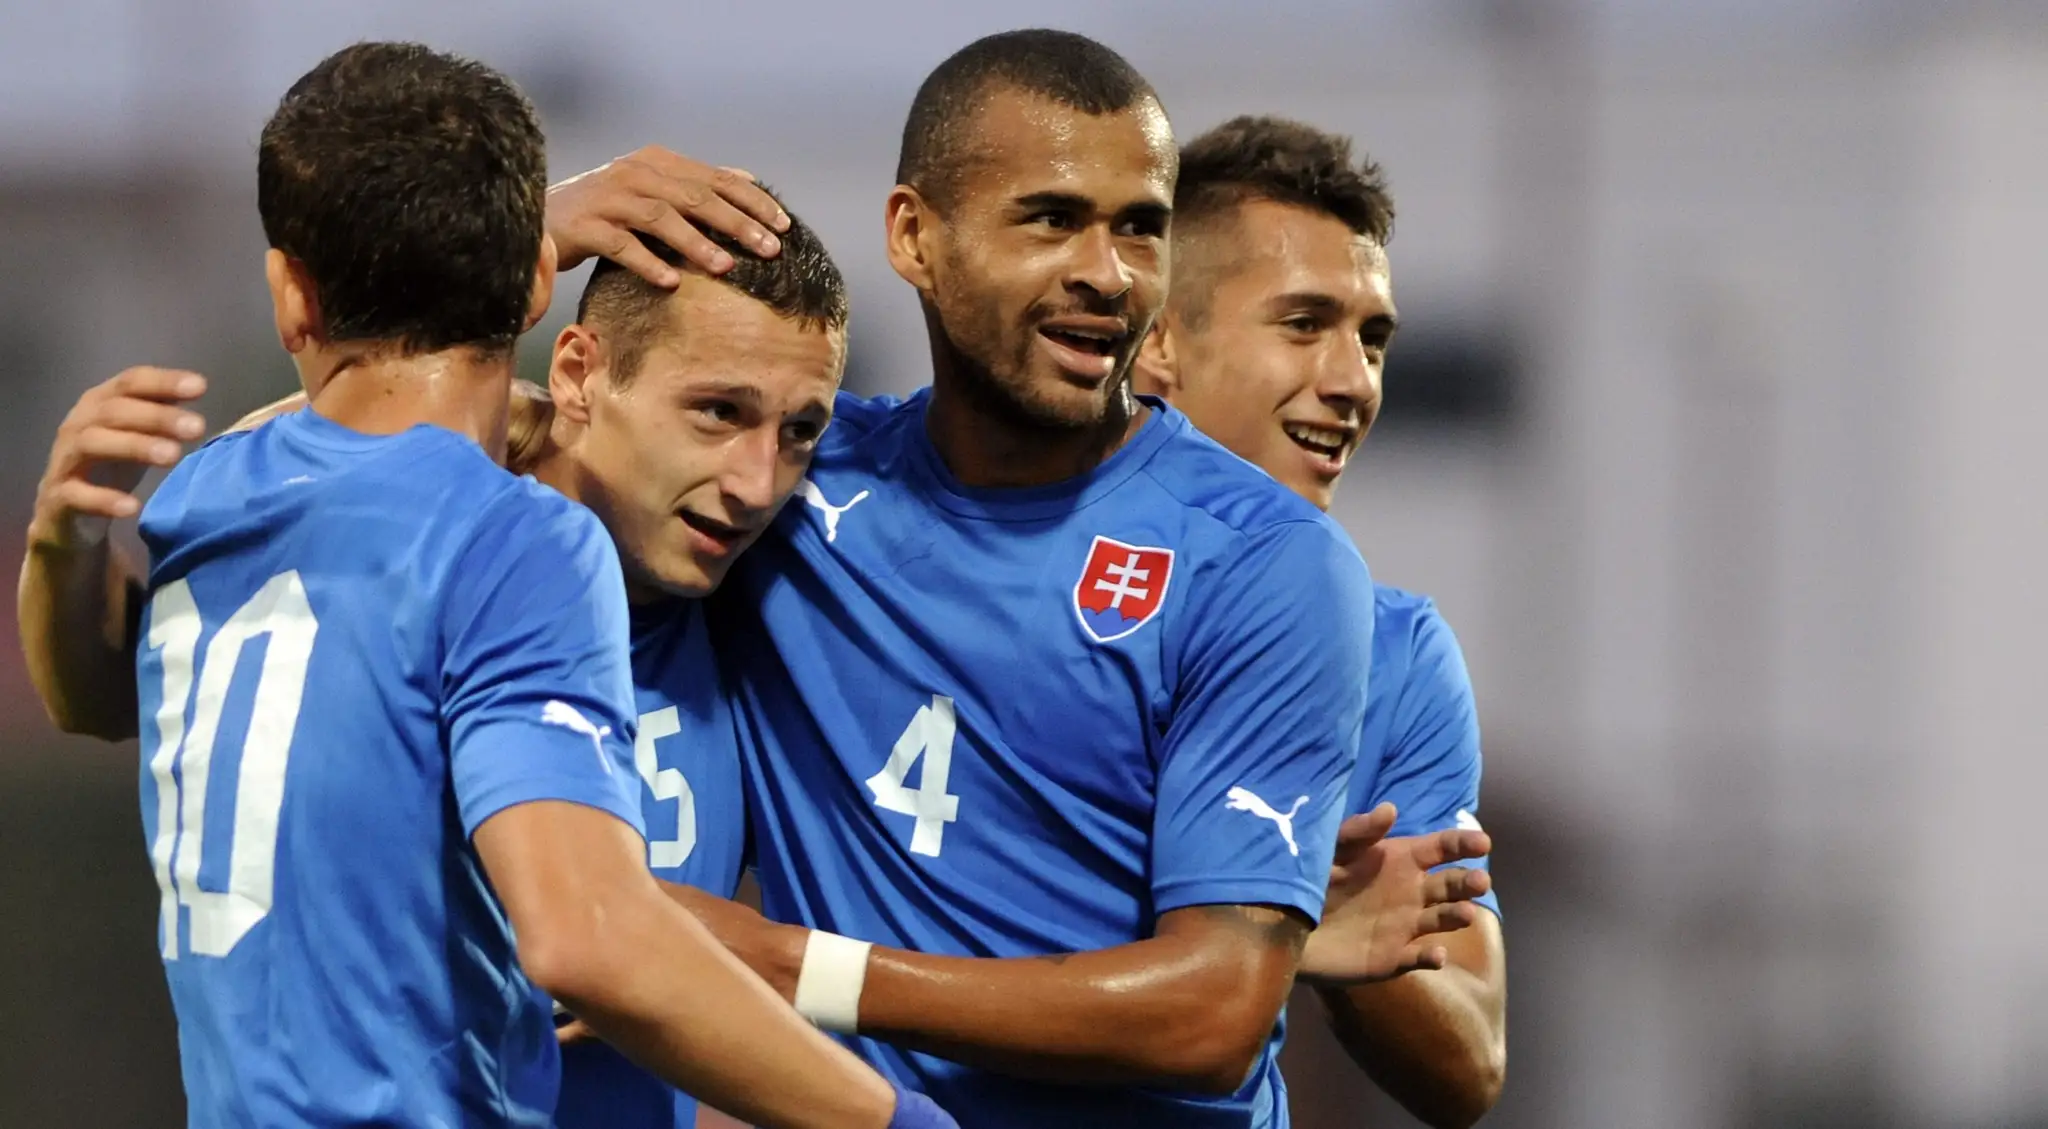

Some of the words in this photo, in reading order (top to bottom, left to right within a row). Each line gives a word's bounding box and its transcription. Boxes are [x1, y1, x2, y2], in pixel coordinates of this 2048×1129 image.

[149, 569, 318, 960] 10
[635, 705, 696, 867] 5
[866, 695, 958, 857] 4
